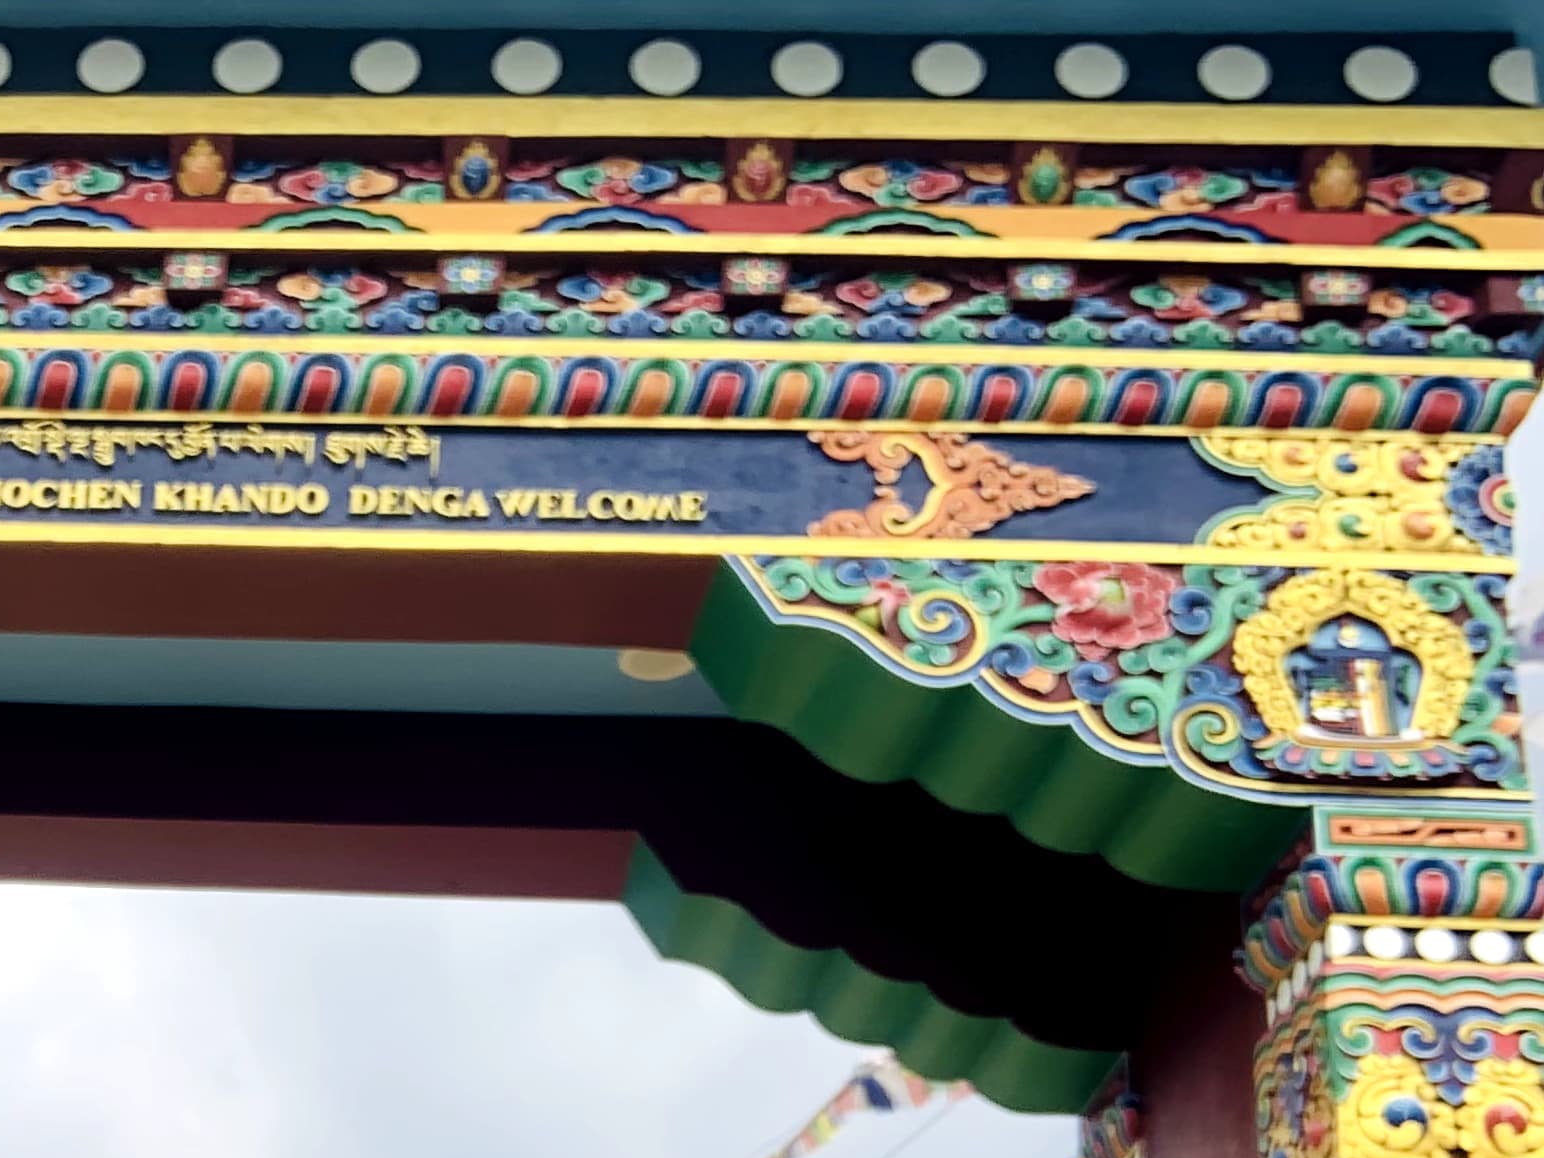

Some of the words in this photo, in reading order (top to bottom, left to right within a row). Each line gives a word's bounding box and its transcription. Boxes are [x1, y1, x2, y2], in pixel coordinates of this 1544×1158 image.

[153, 481, 330, 515] KHANDO
[348, 484, 491, 519] DENGA
[494, 488, 708, 522] WELCOME
